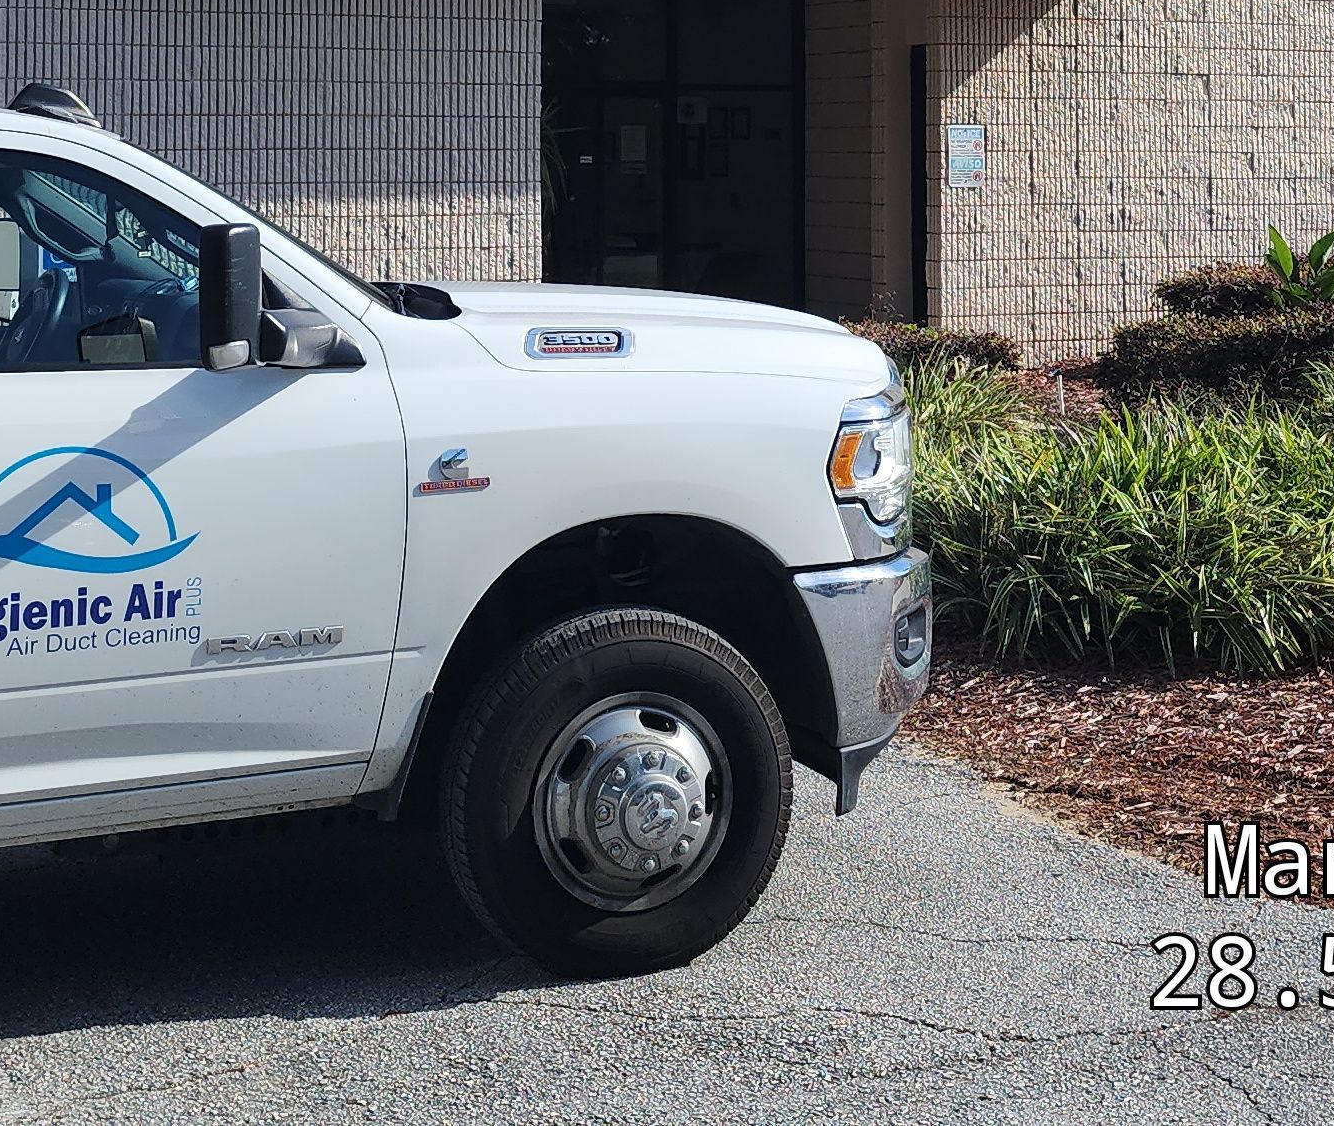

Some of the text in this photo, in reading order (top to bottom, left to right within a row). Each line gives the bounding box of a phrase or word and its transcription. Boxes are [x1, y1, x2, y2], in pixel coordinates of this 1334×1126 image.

[951, 128, 981, 138] NOTICE
[952, 159, 982, 169] AVISO
[543, 334, 617, 345] 3500
[123, 580, 182, 622] Air
[185, 576, 203, 617] PLUS
[6, 624, 202, 657] Air Duct Cleaning
[205, 625, 345, 656] RAM
